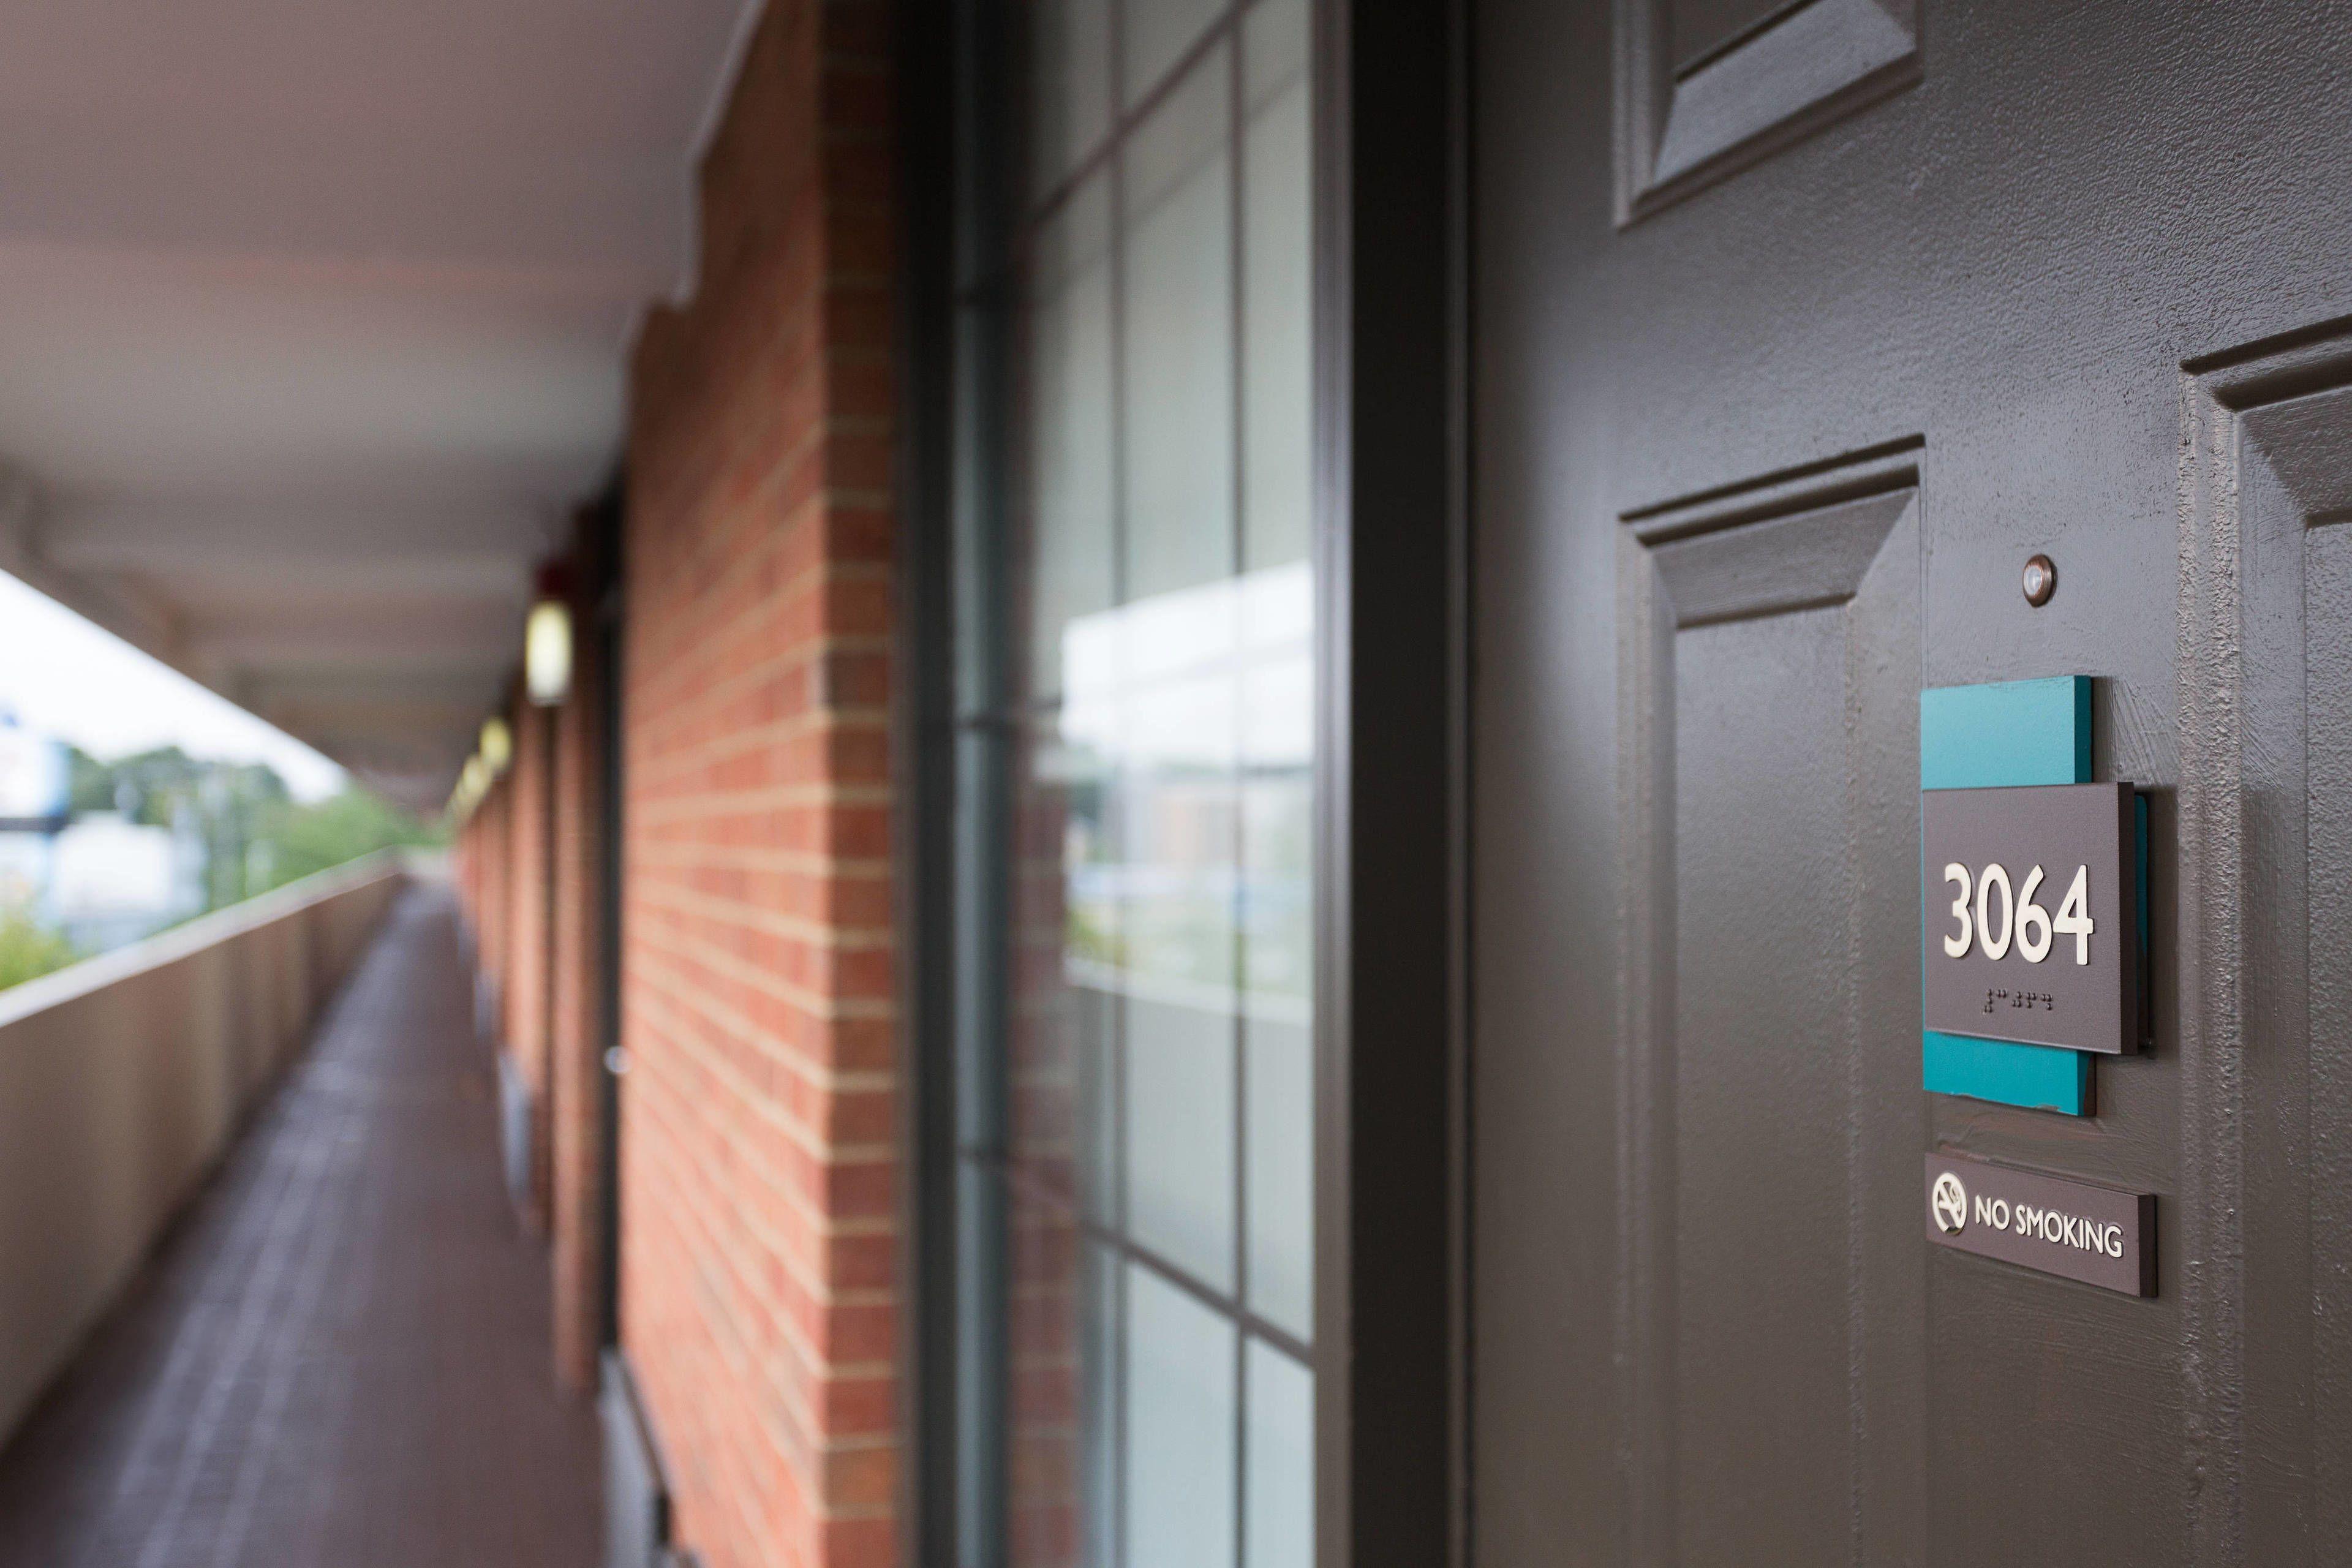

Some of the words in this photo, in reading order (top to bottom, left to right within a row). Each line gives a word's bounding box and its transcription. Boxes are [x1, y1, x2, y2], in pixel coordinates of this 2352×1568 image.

[1944, 862, 2094, 965] 3064
[1975, 1194, 2010, 1231] NO
[2015, 1204, 2123, 1259] SMOKING
